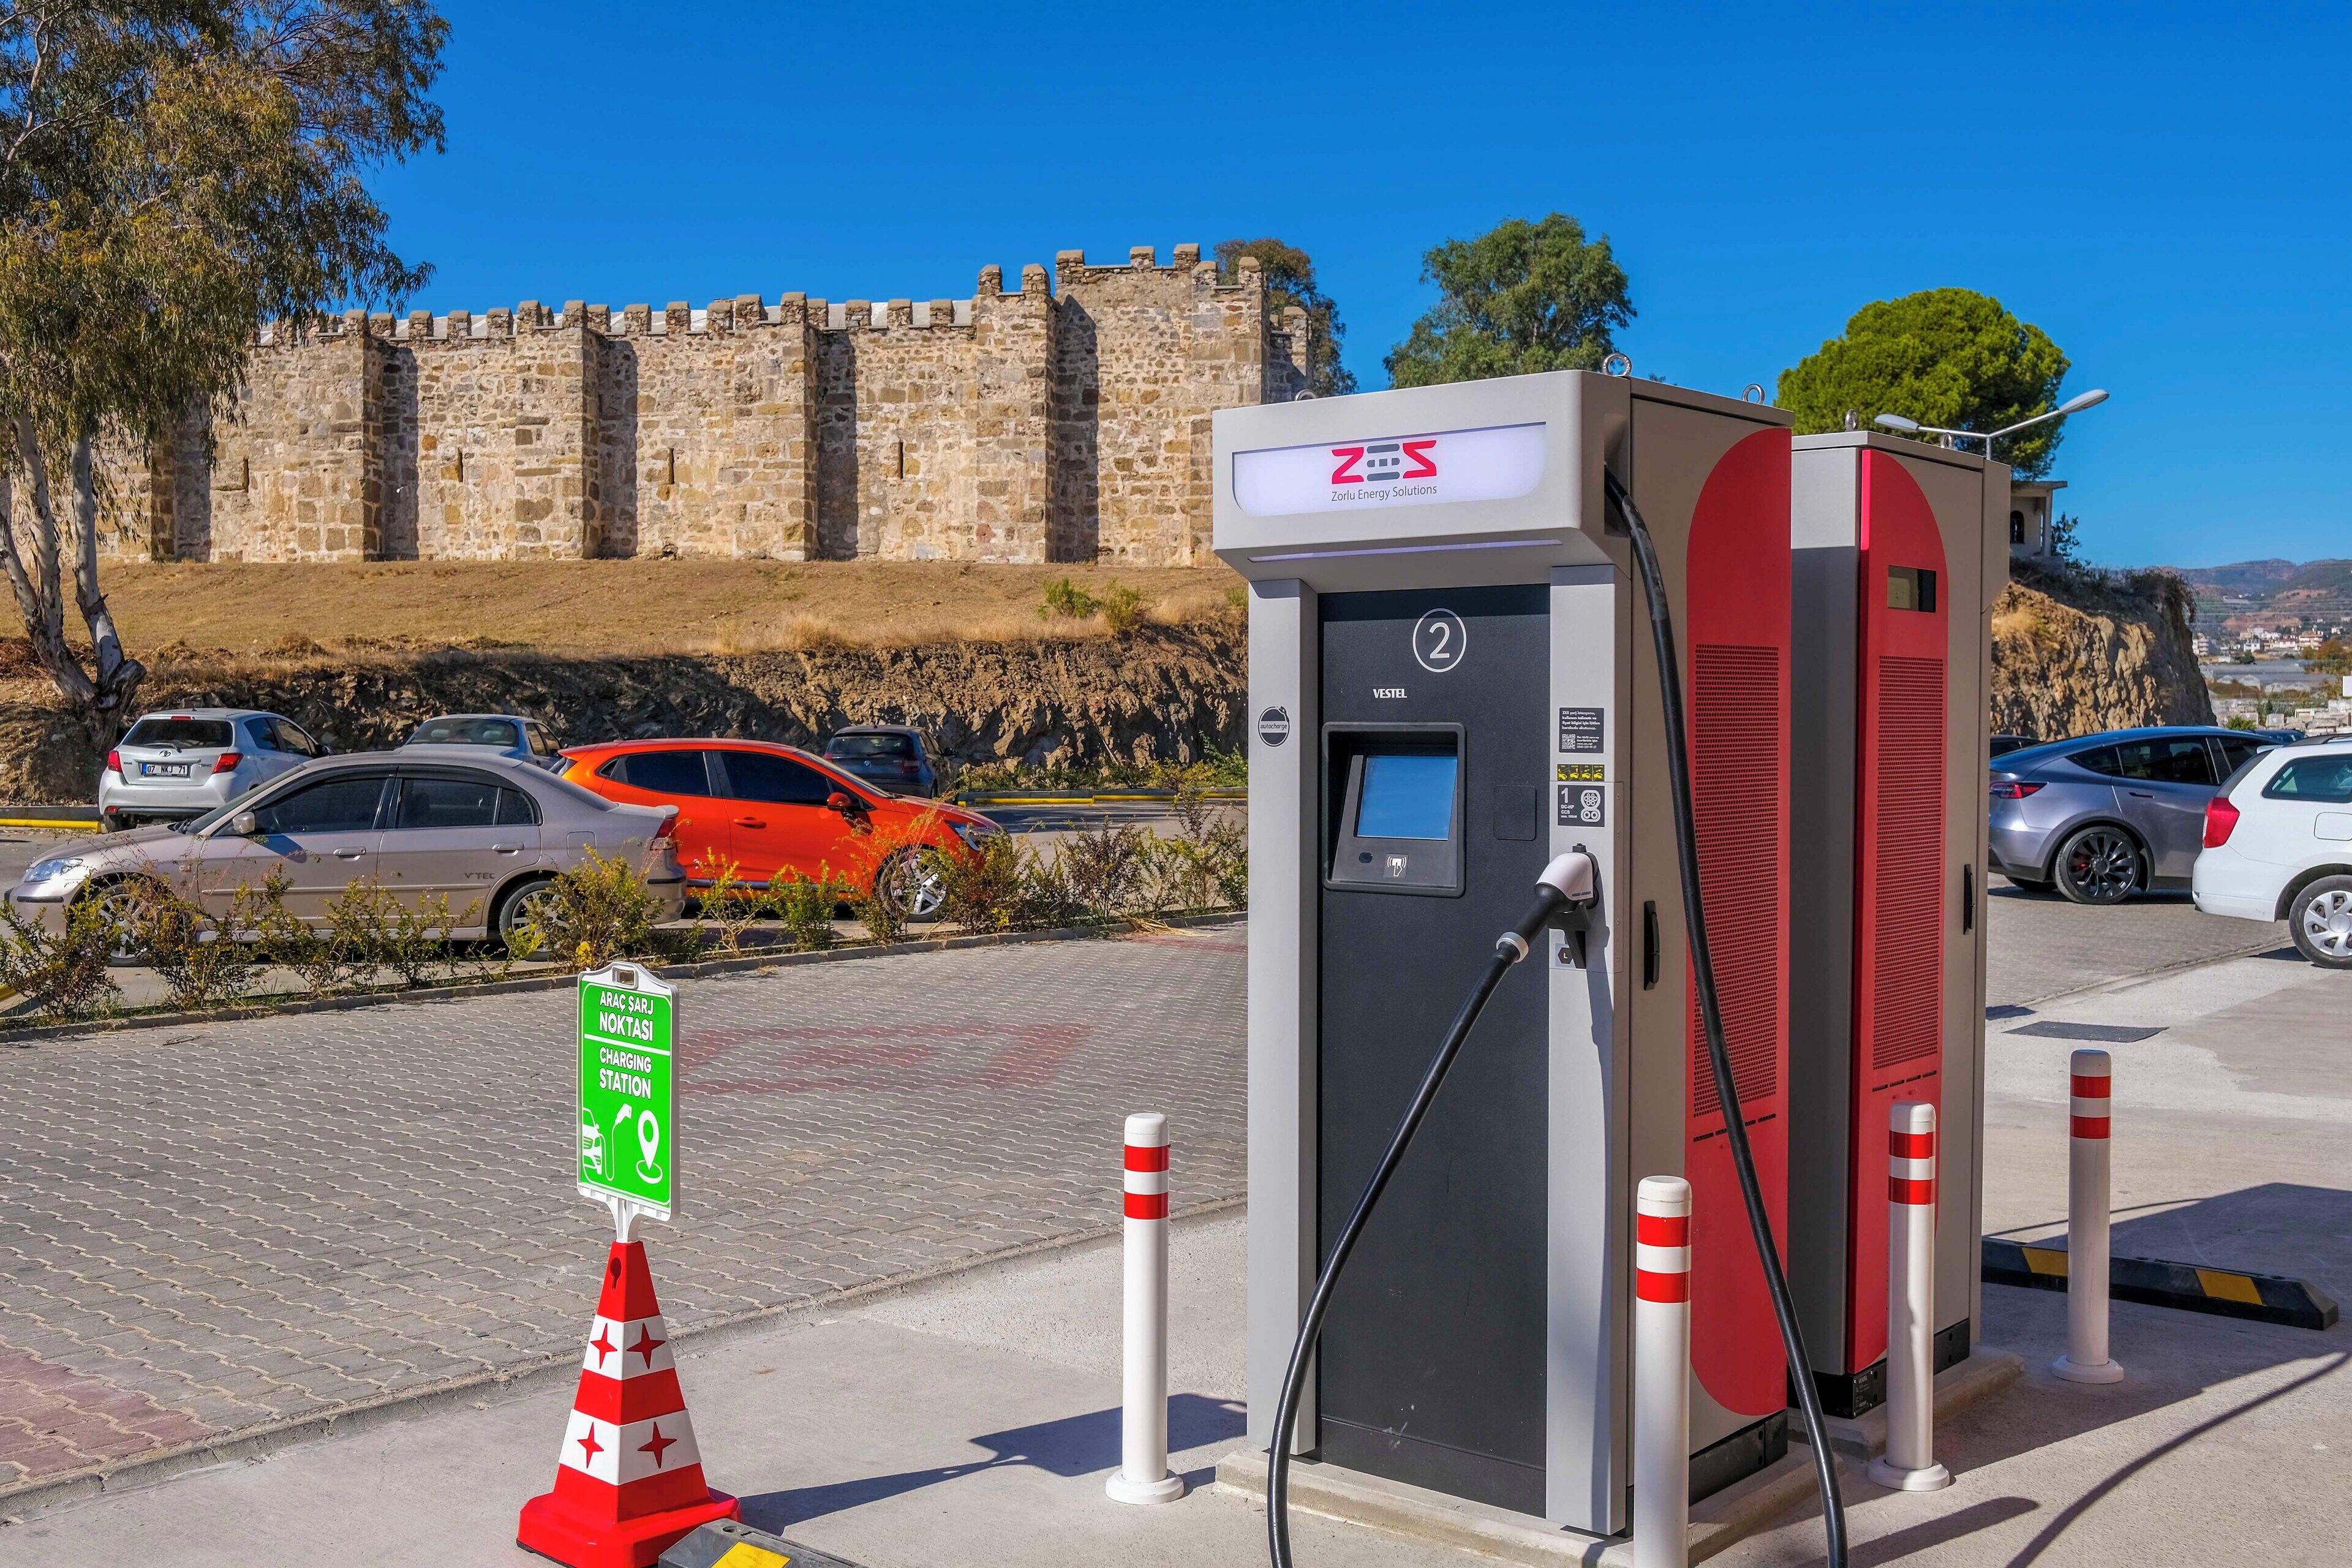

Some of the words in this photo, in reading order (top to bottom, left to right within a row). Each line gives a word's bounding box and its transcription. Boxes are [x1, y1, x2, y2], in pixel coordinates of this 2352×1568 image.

[1332, 440, 1437, 484] ZES
[1332, 491, 1355, 502] Zorlu
[1358, 488, 1390, 502] Energy
[1393, 484, 1438, 497] Solutions
[1429, 622, 1450, 659] 2
[1373, 688, 1408, 698] VESTEL
[147, 765, 155, 774] 07
[160, 765, 173, 774] NKJ
[178, 765, 186, 774] 71
[1561, 787, 1568, 803] 1
[599, 990, 627, 1012] ARAÇ
[627, 996, 654, 1017] ŞARJ
[598, 1011, 654, 1042] NOKTASI
[599, 1046, 652, 1074] CHARGING
[598, 1067, 652, 1100] STATION
